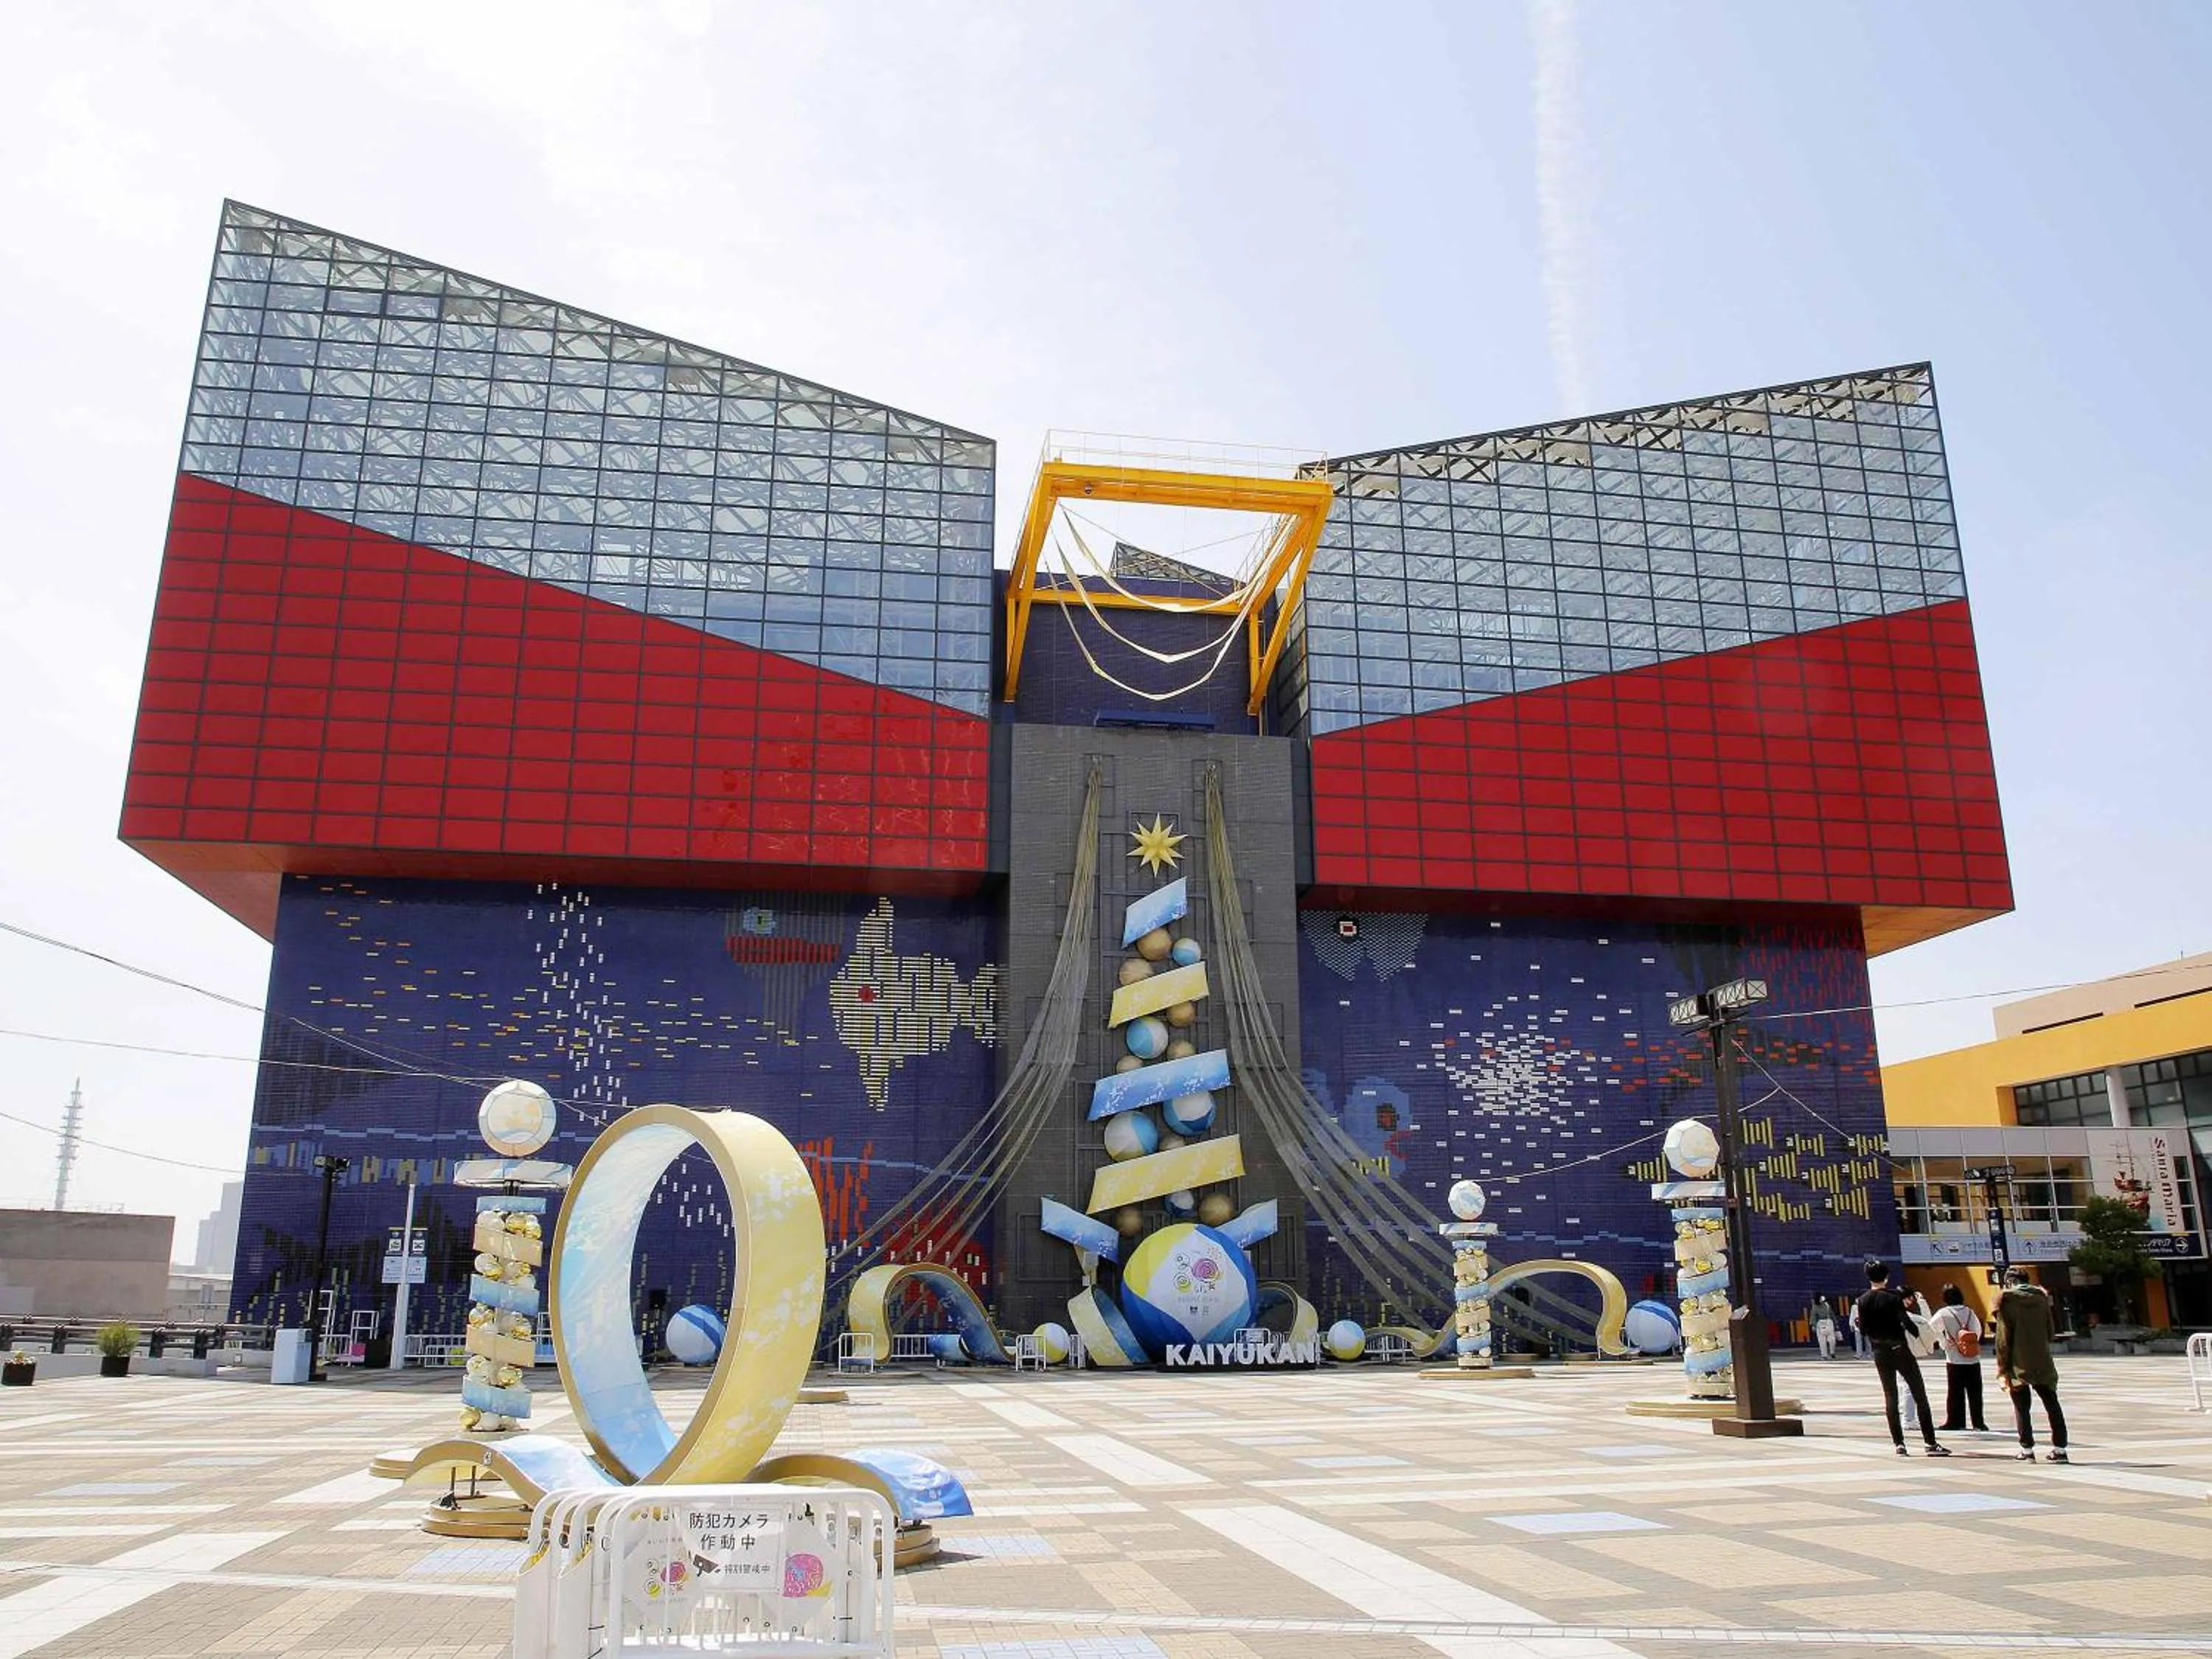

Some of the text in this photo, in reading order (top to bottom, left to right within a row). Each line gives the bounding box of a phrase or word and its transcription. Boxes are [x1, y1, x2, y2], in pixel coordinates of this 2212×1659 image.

[1166, 1343, 1315, 1366] KAIYUKAN
[689, 1512, 768, 1528] 防犯カメラ
[700, 1534, 756, 1550] 作動中
